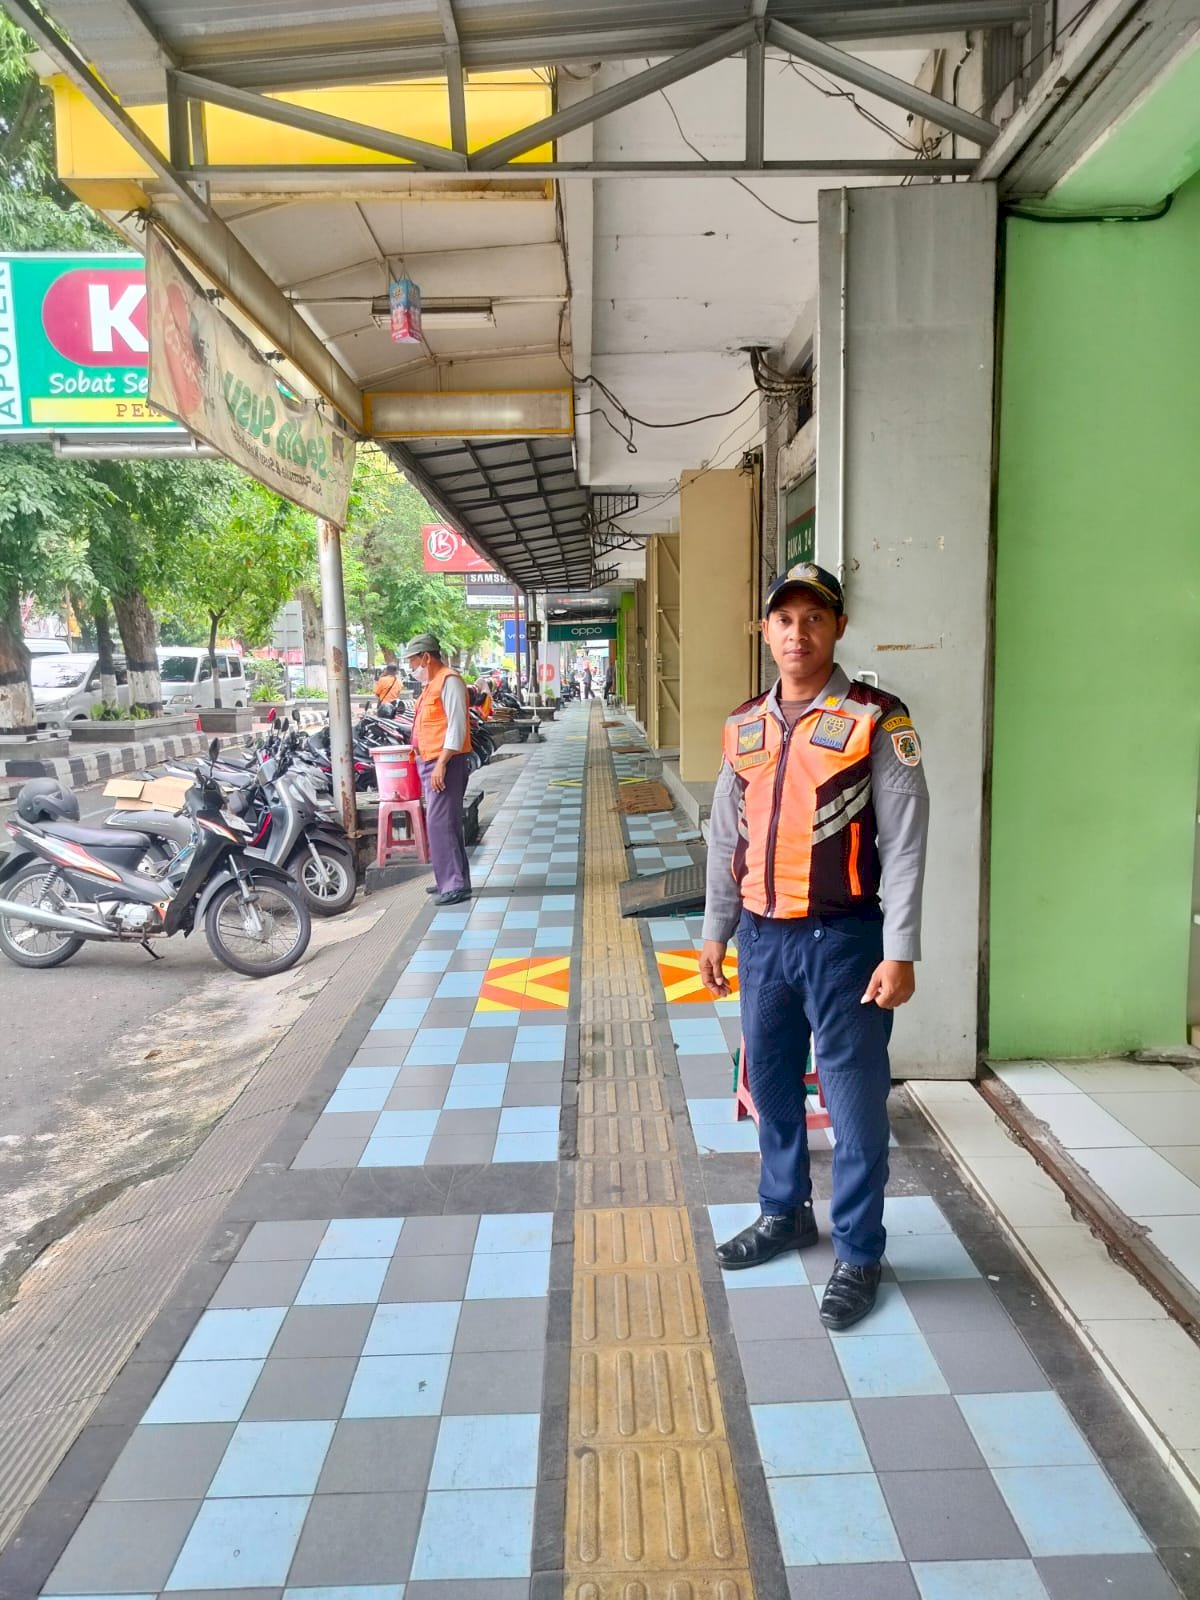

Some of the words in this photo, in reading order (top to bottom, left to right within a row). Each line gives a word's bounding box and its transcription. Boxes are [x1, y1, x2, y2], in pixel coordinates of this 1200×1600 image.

[50, 371, 115, 394] Sobat
[787, 533, 802, 561] BUKA
[804, 527, 812, 551] 24
[571, 626, 602, 637] oppo
